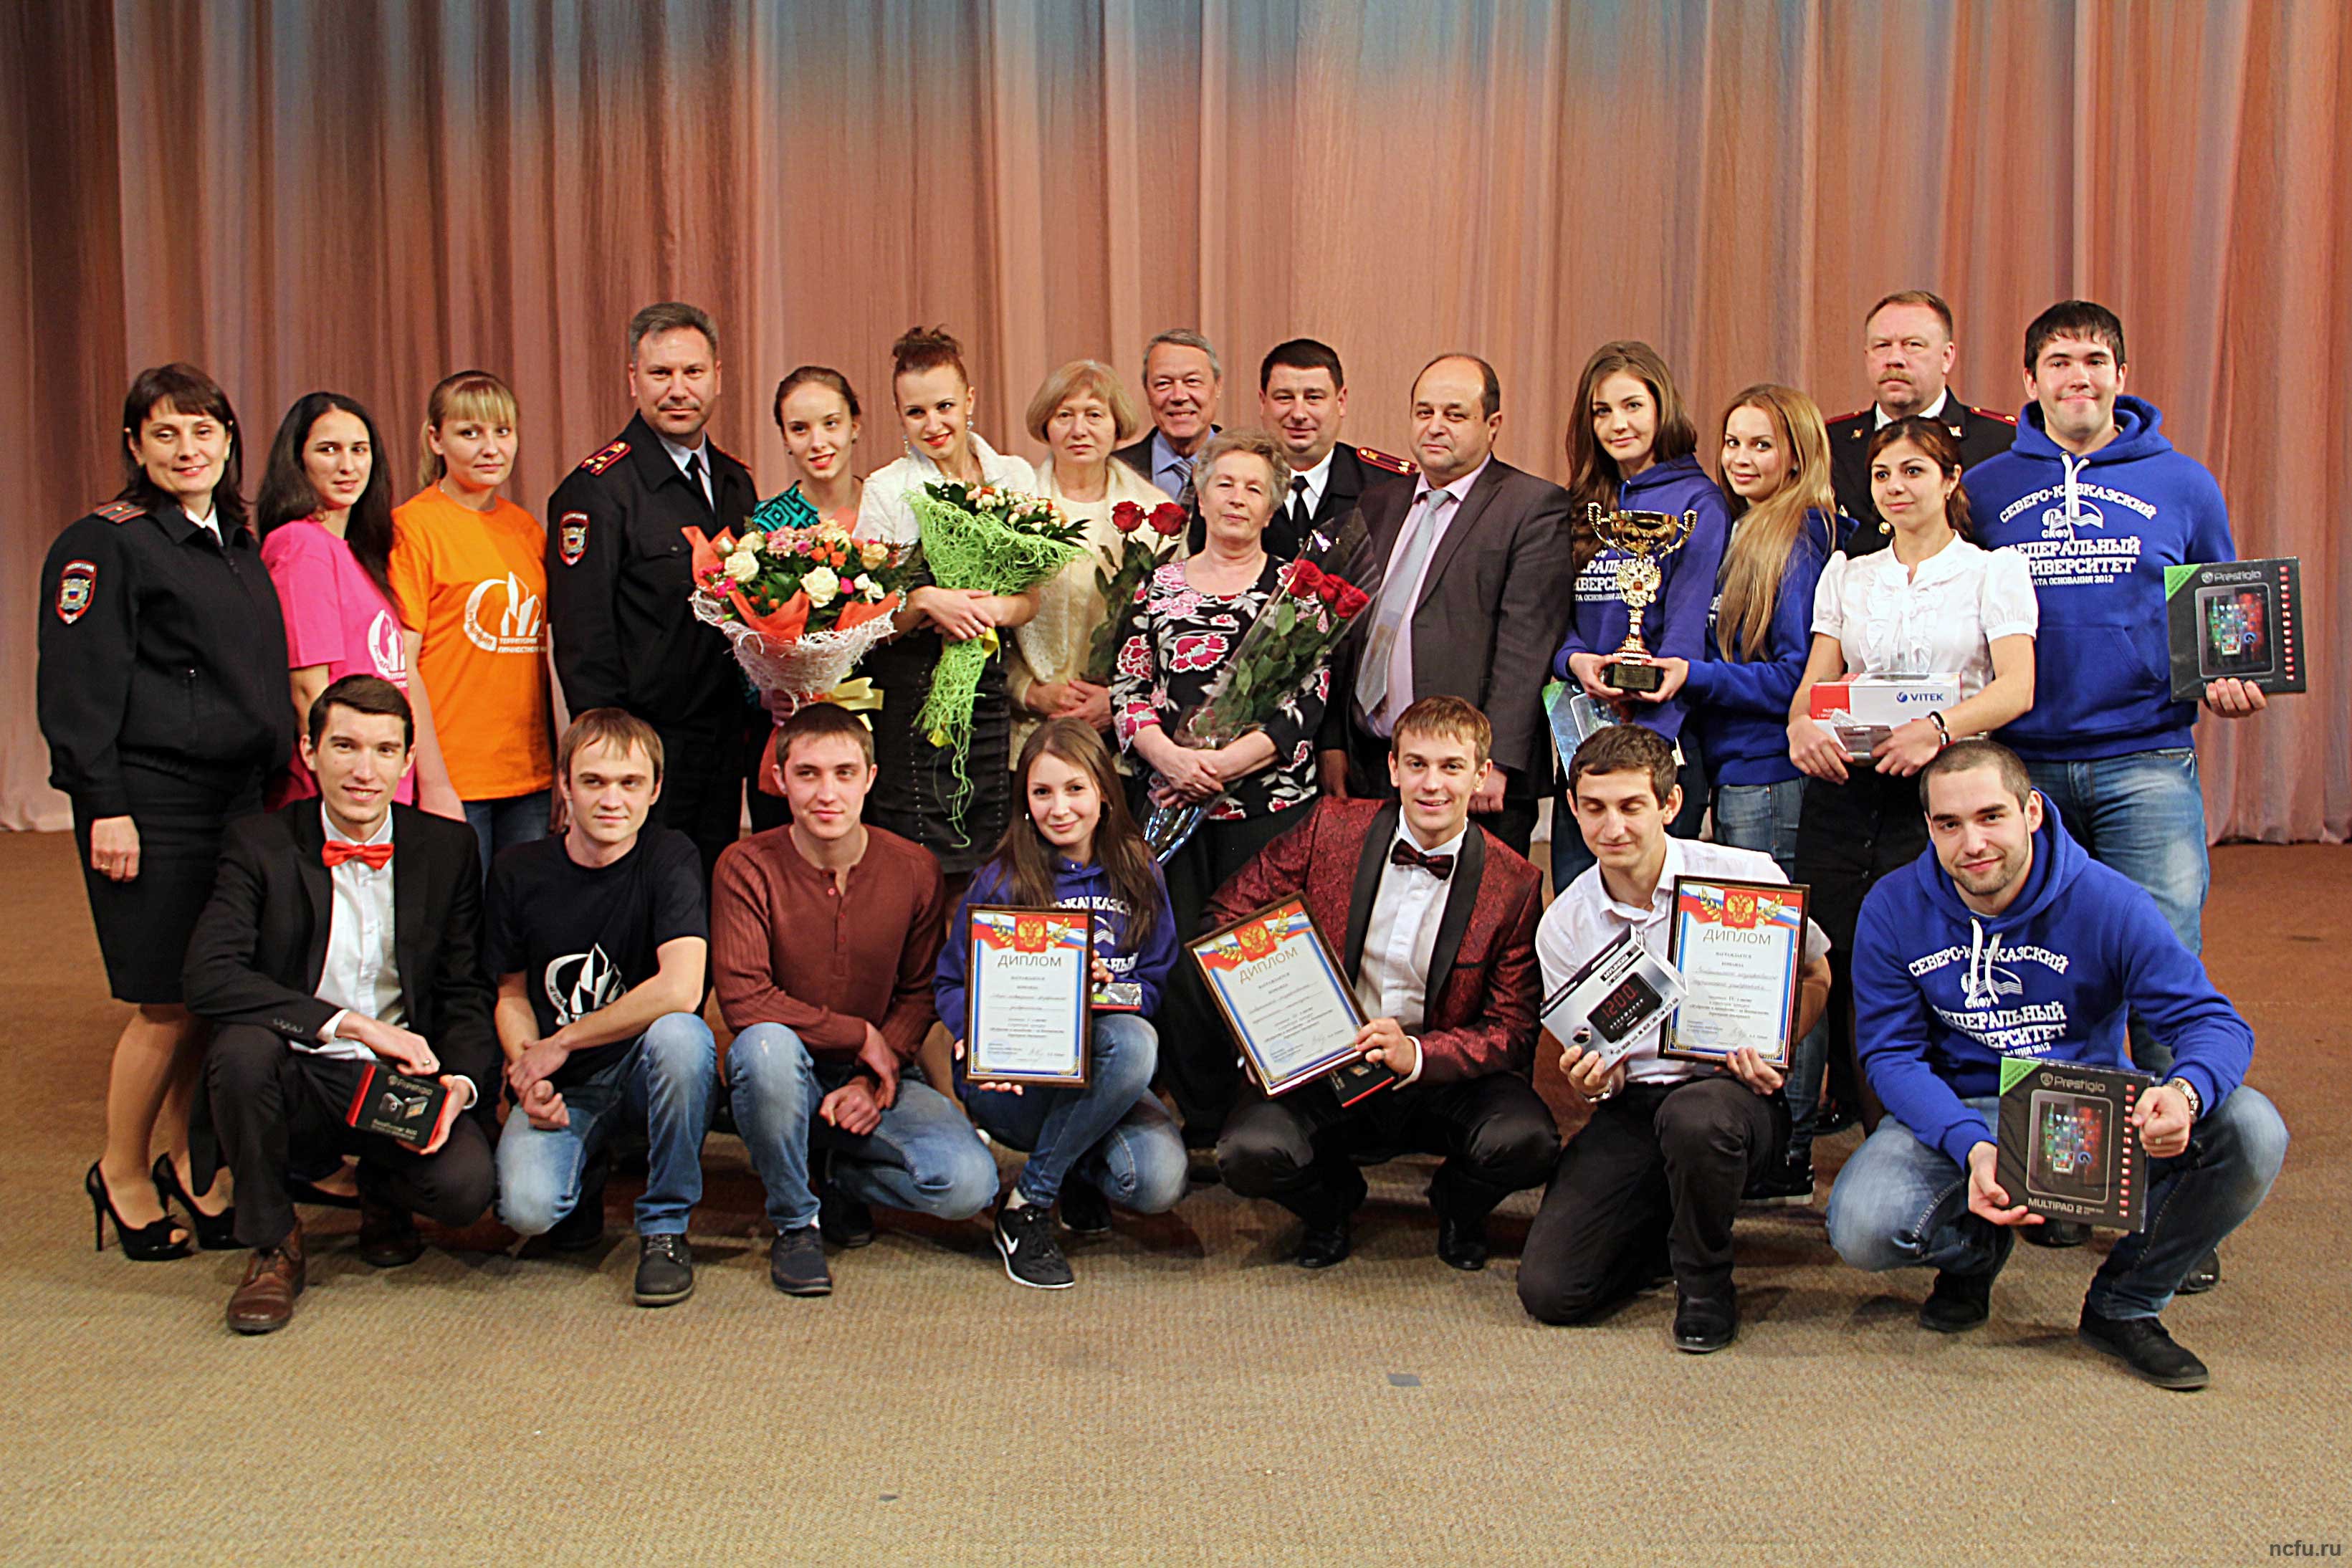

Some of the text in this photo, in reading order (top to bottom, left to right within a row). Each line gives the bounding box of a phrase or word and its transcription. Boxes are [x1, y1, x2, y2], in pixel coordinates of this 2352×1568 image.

[1999, 482, 2157, 523] СЕВЕРО-КВКАЗСКИЙ
[2009, 535, 2141, 559] ЕДЕРАЛЬНЫЙ
[2029, 557, 2136, 576] ИВЕРСИТЕТ
[2094, 574, 2114, 583] 2012
[2214, 570, 2262, 582] Prestigio
[1911, 692, 1944, 702] VITEK
[1702, 928, 1772, 945] ДИПЛОМ
[997, 955, 1061, 967] ДИПЛОМ
[1239, 946, 1299, 985] ДИПЛОМ
[2055, 1076, 2106, 1094] Prestigio
[2028, 1197, 2074, 1214] MULTIPAD
[2075, 1205, 2083, 1215] 2
